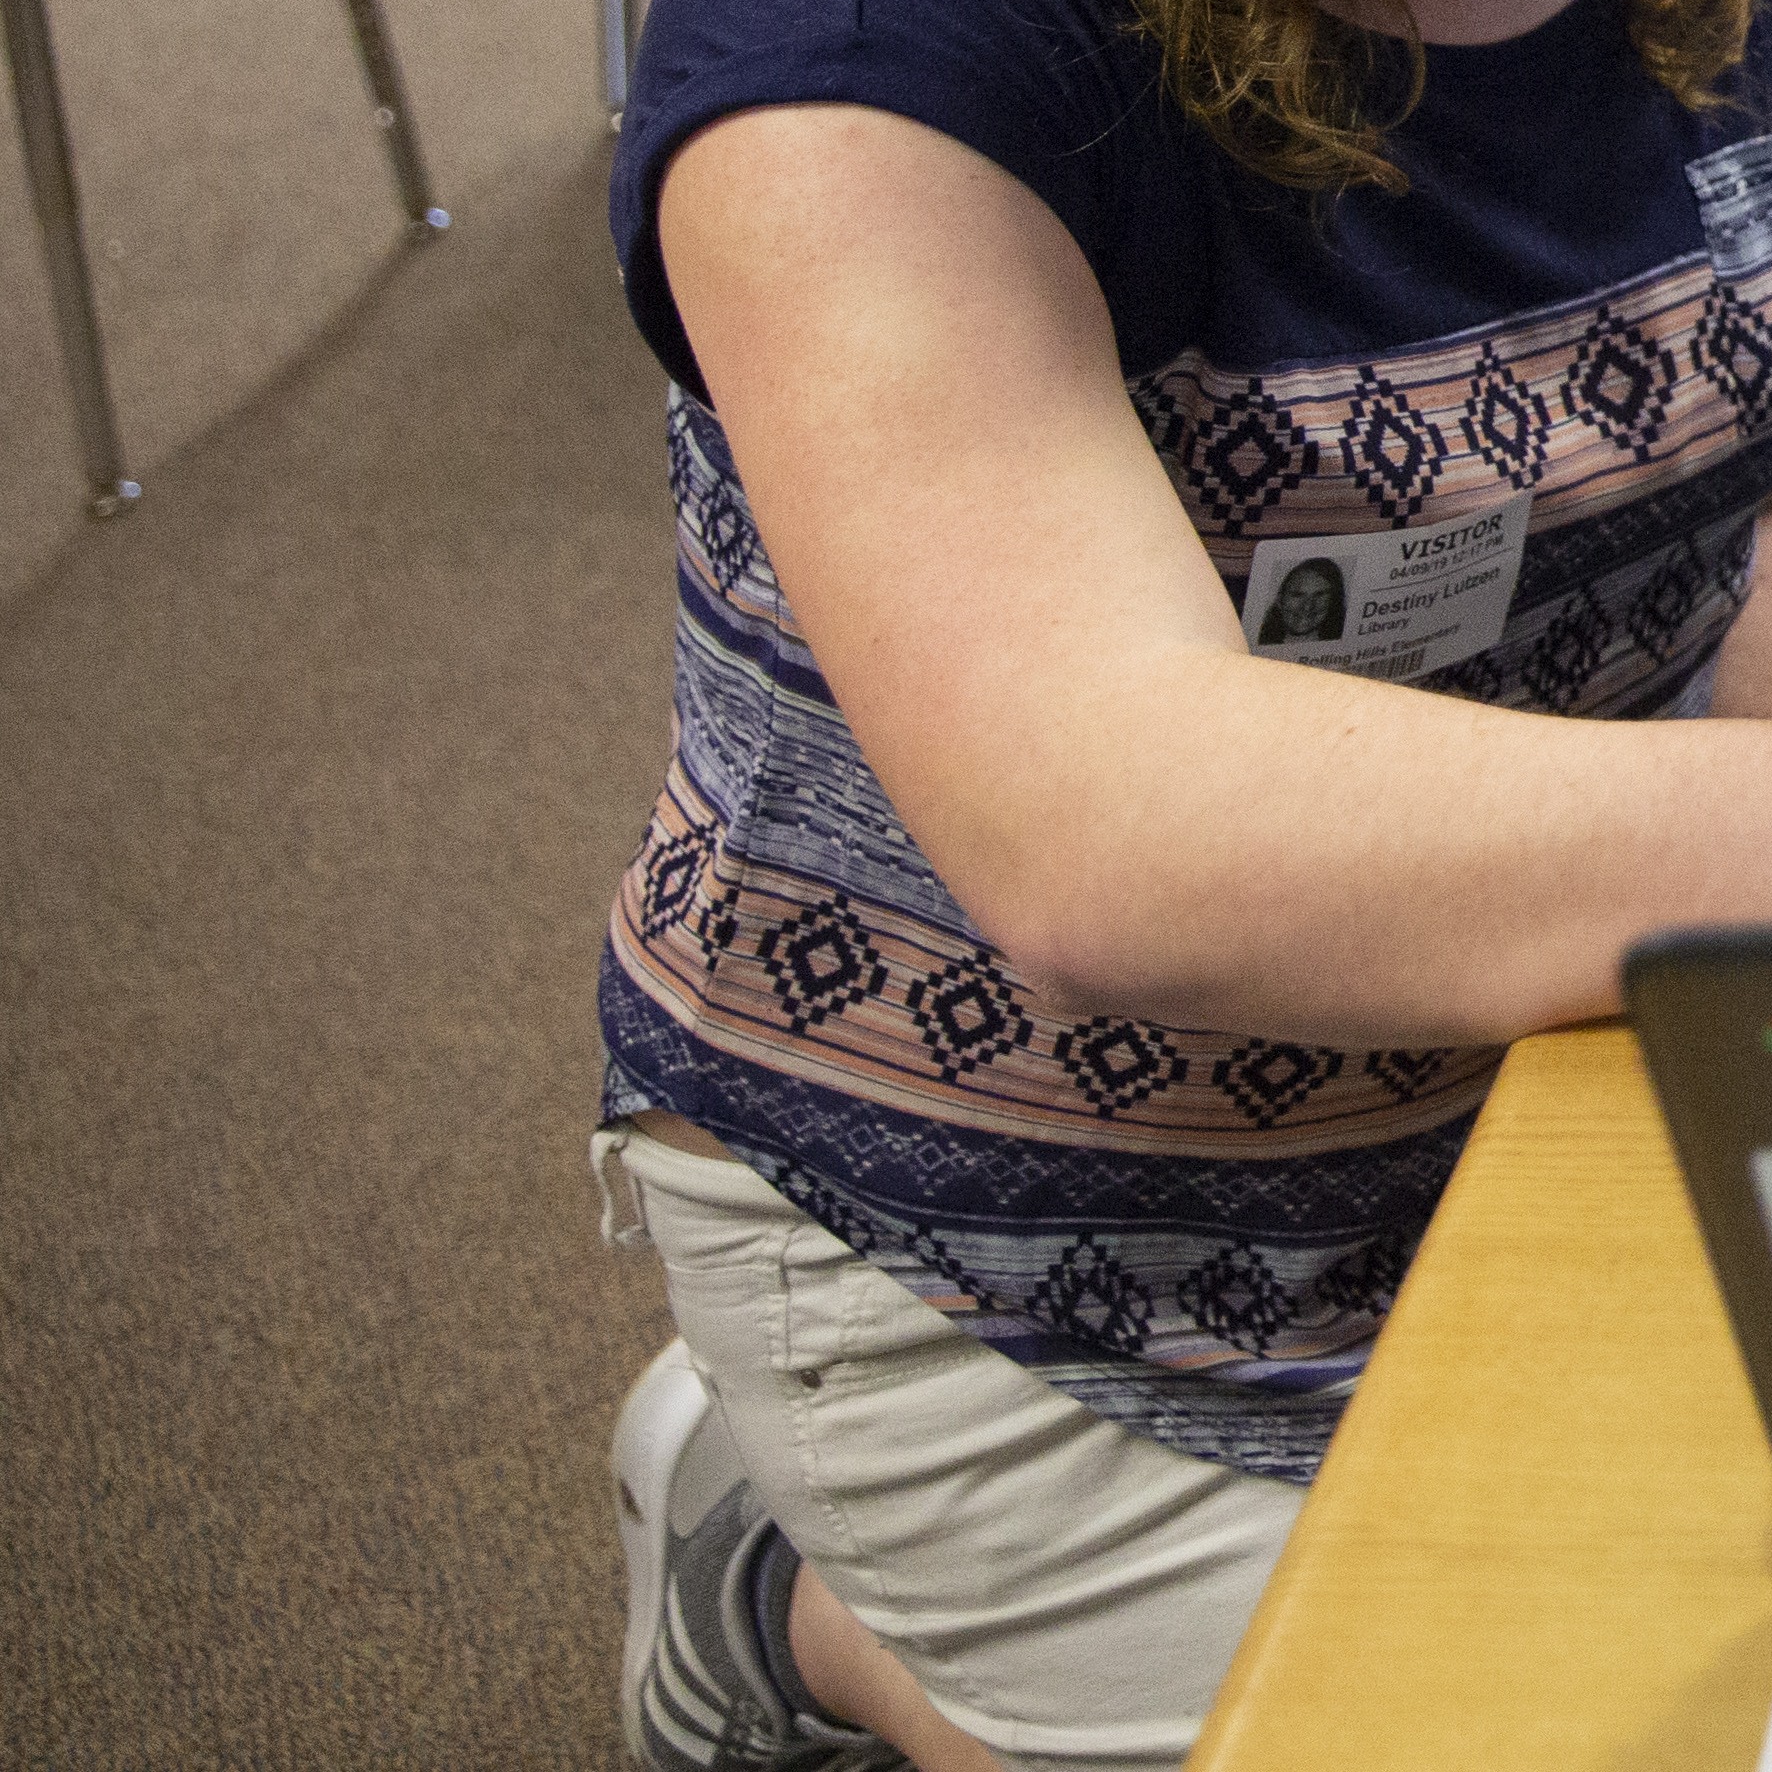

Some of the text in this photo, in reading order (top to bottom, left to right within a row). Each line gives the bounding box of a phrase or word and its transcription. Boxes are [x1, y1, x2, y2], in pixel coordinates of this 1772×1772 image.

[1401, 512, 1503, 561] VISITOR
[1362, 590, 1439, 619] Destiny
[1357, 616, 1411, 636] Library
[1356, 645, 1387, 661] Hills
